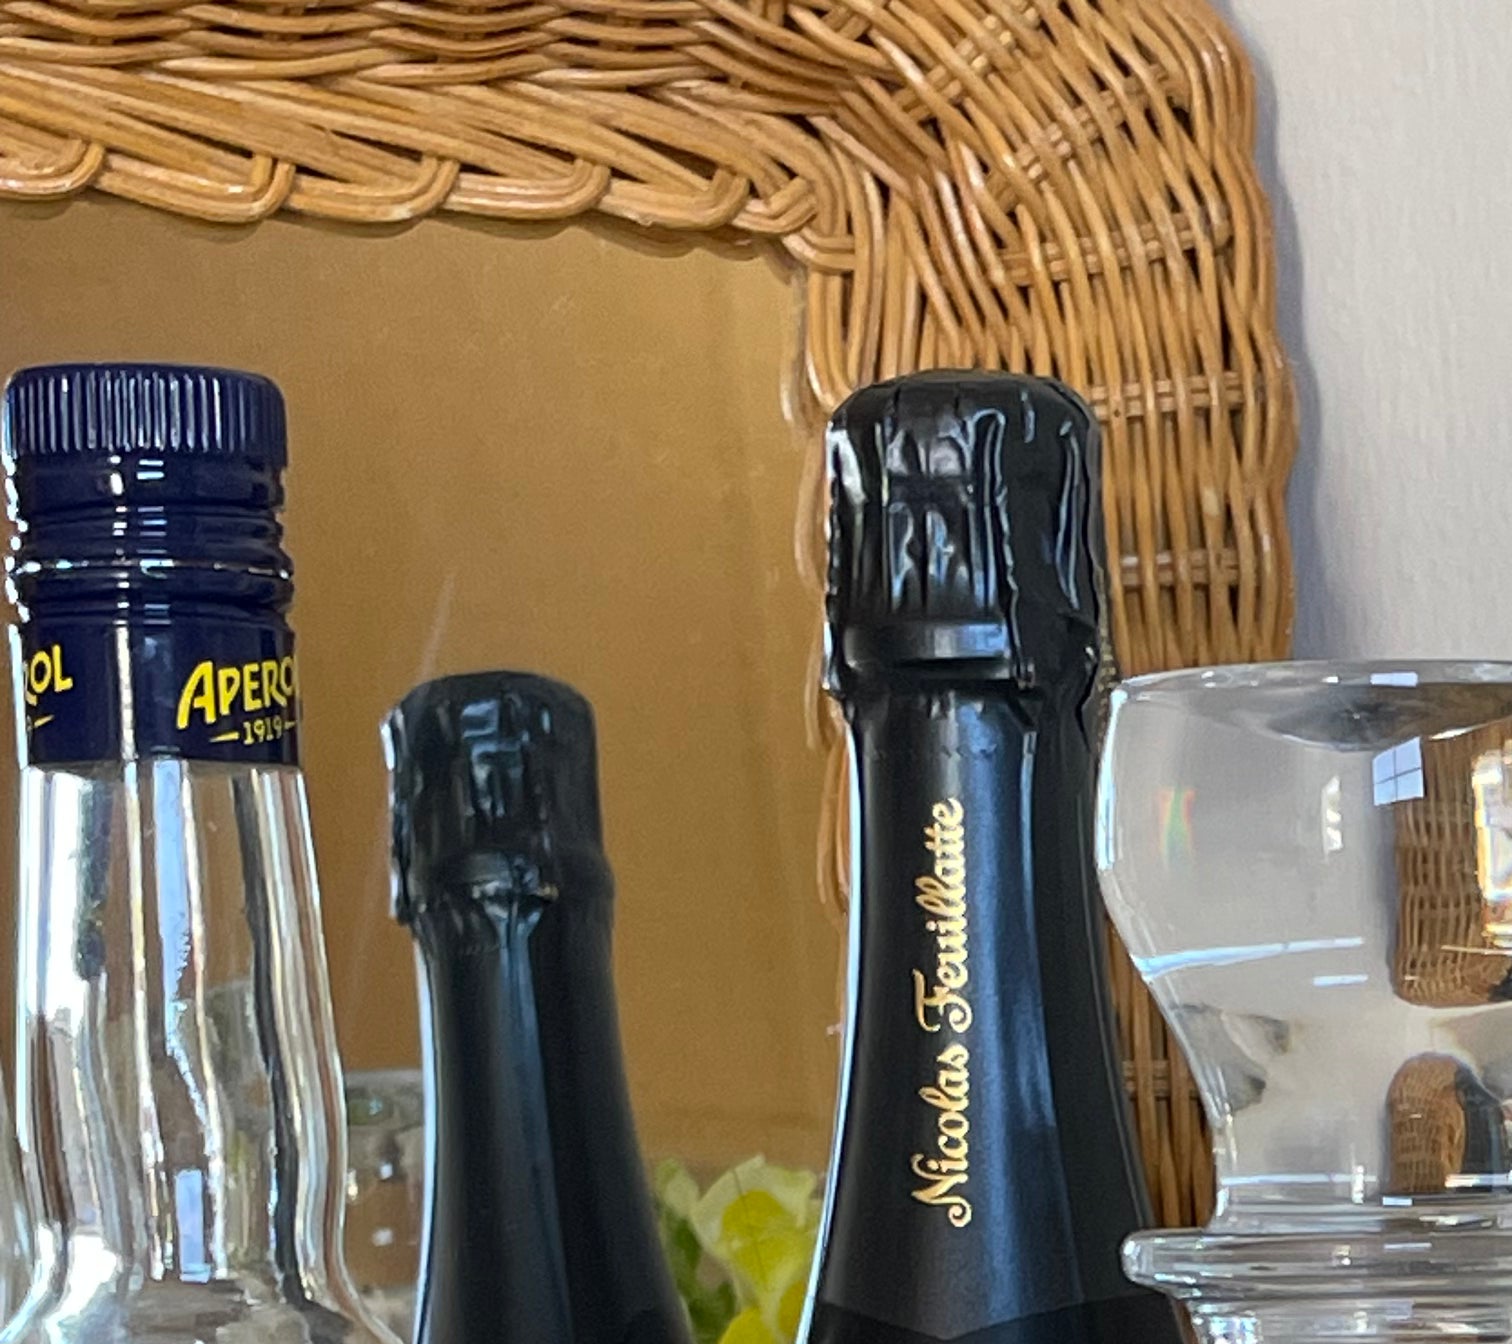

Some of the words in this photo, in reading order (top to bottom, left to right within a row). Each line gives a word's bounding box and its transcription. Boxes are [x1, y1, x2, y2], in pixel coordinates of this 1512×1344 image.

[243, 715, 283, 745] 1919
[912, 798, 973, 1032] Feuillatte
[911, 1043, 972, 1227] Nicolas
